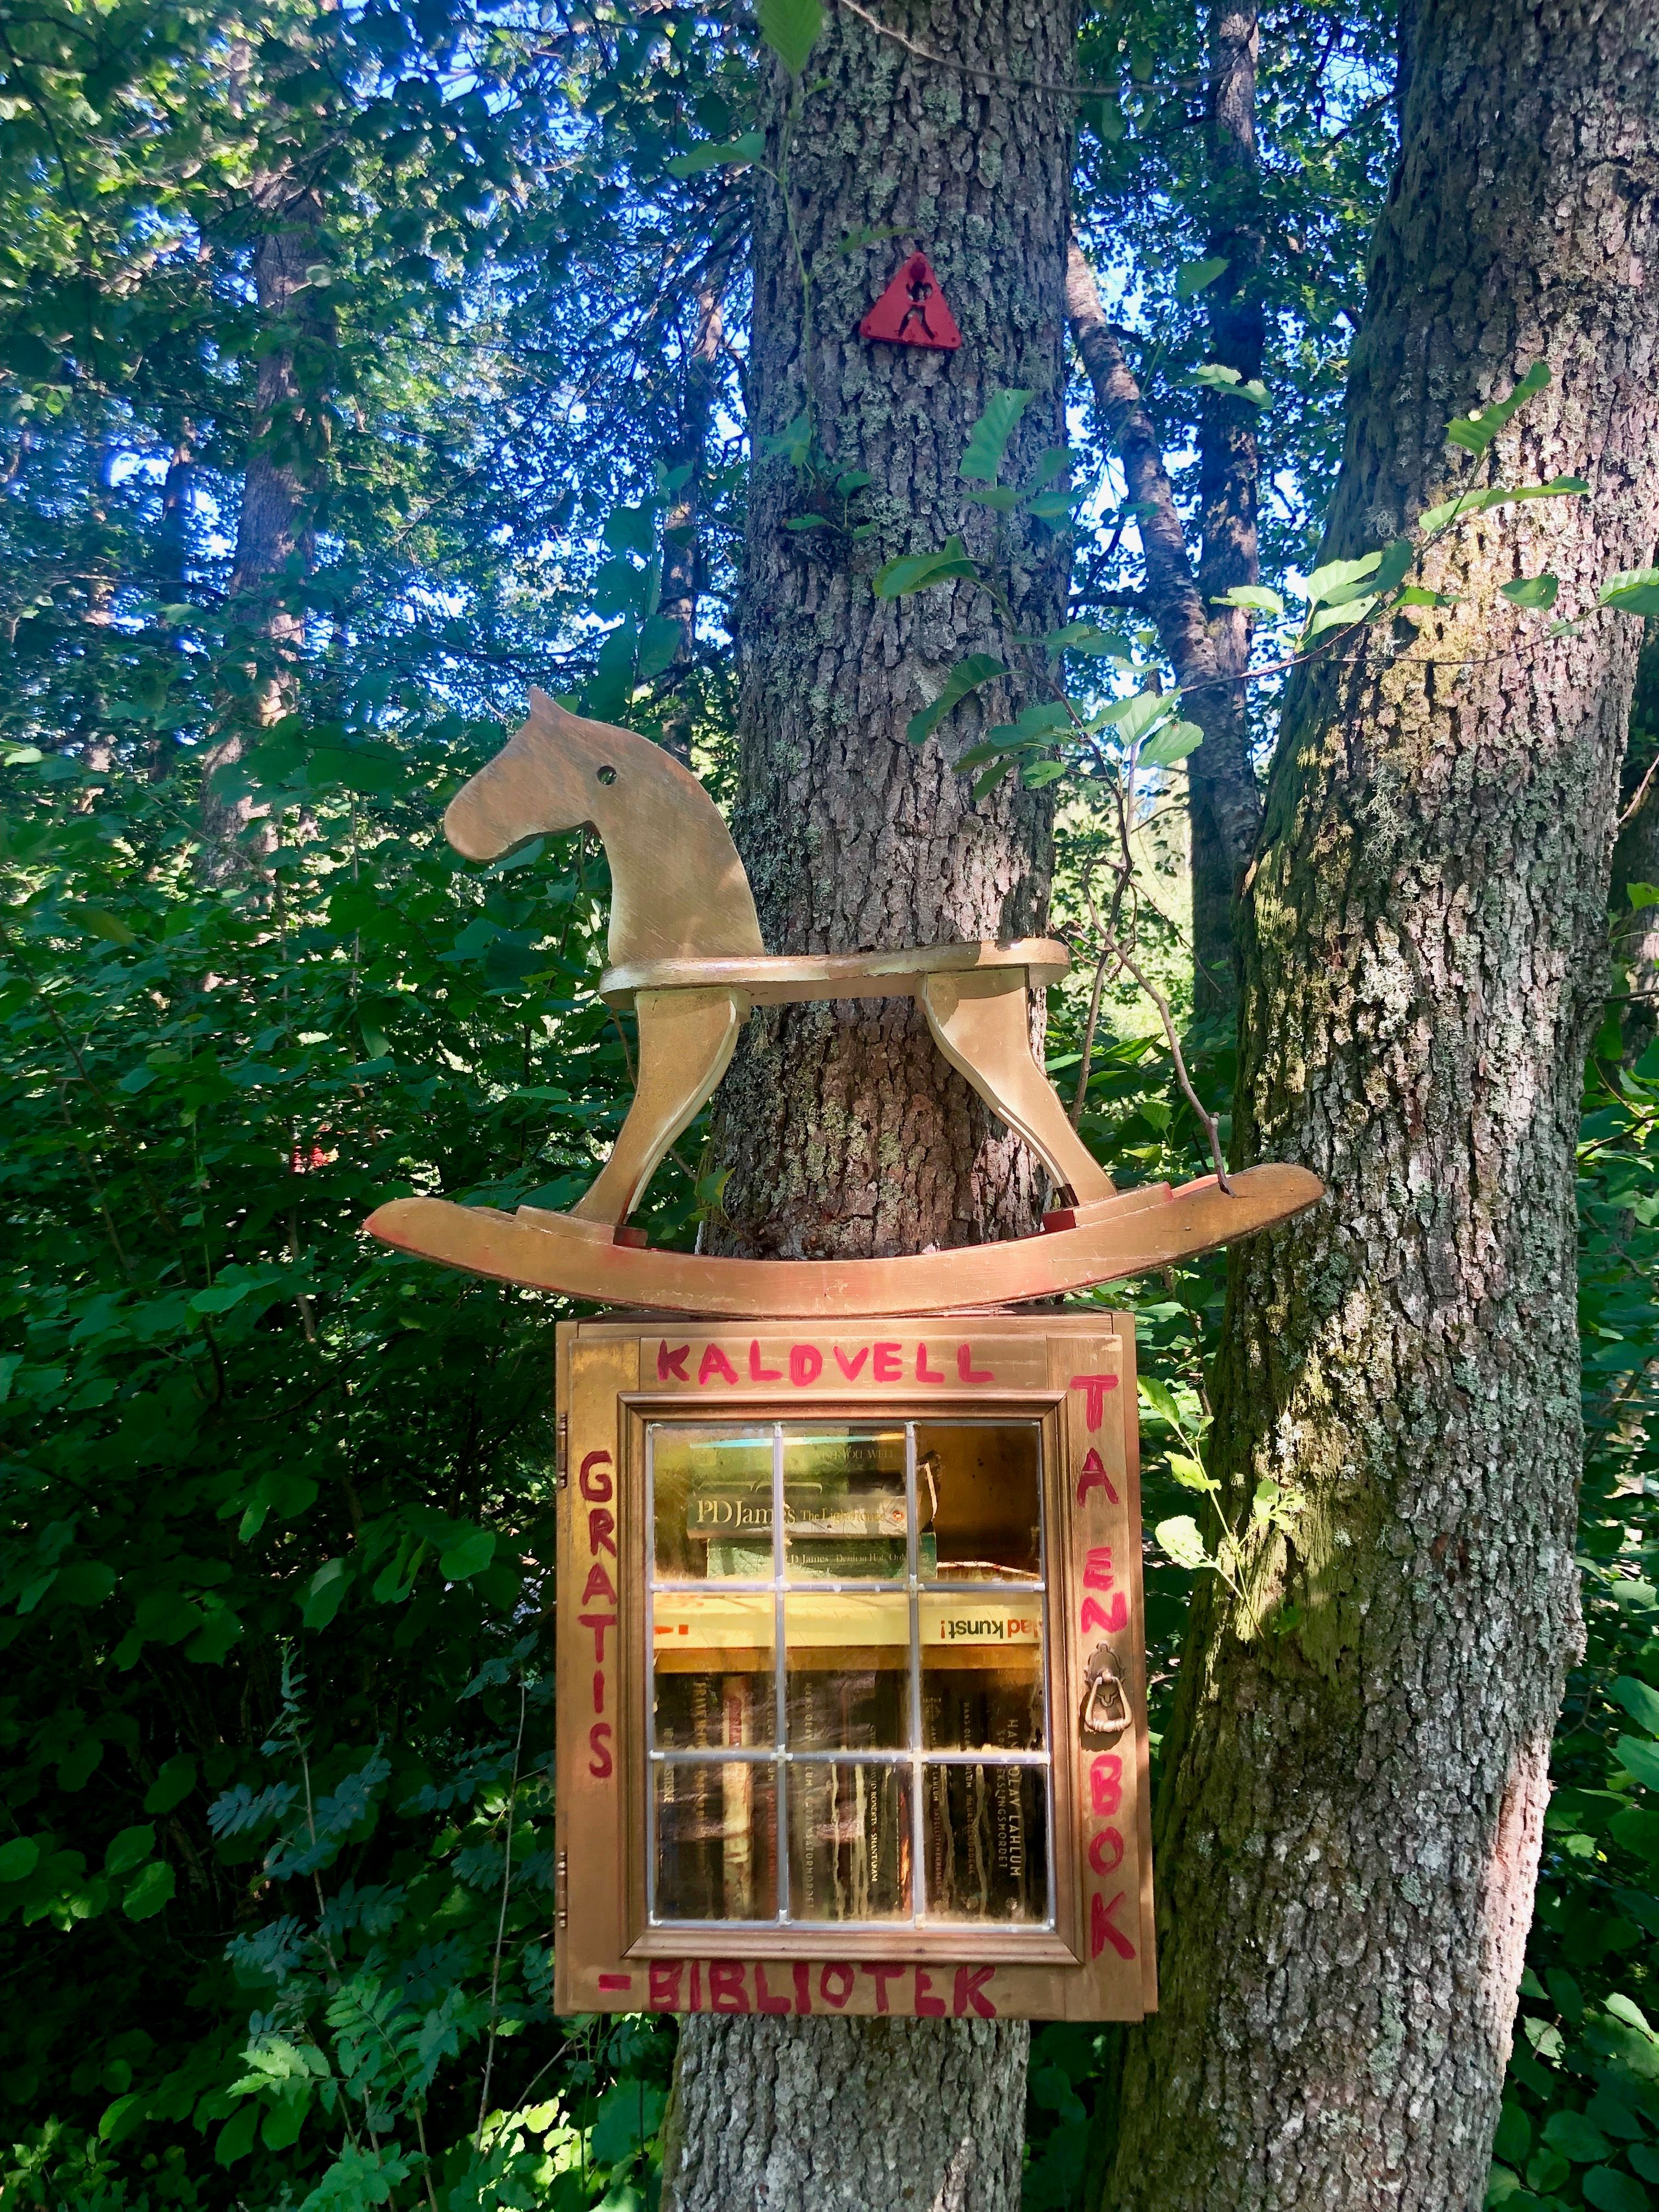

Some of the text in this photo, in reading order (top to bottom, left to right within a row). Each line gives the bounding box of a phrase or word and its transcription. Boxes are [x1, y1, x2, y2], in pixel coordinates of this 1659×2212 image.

[657, 1339, 996, 1388] KALDVELL
[800, 1509, 819, 1521] The
[579, 1450, 616, 1779] GRATIS
[940, 1620, 1003, 1639] kunst!
[1069, 1374, 1137, 1961] TA EN BOK
[1007, 1718, 1022, 1877] HAN OLAV LAHLUM
